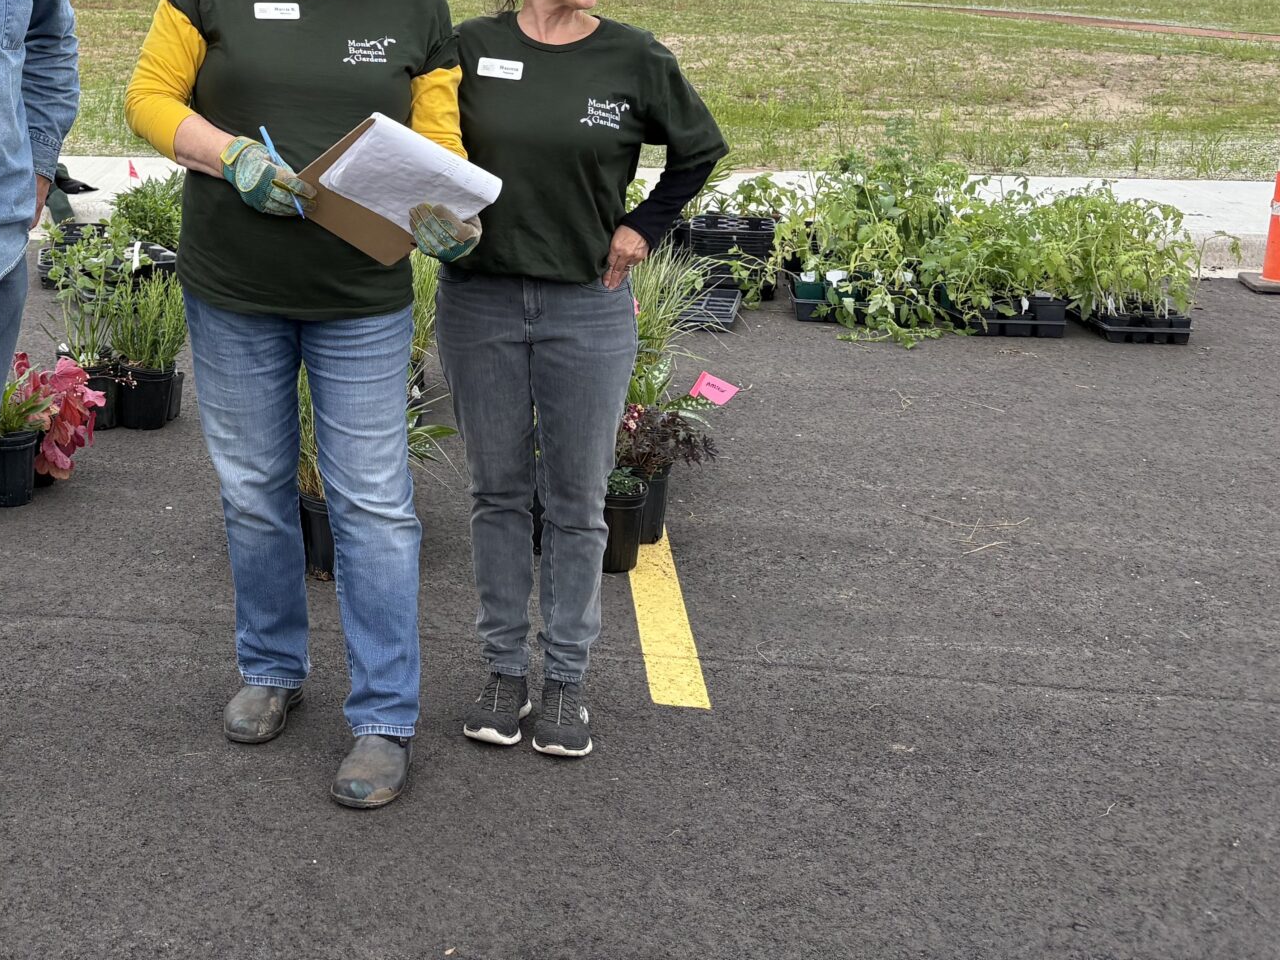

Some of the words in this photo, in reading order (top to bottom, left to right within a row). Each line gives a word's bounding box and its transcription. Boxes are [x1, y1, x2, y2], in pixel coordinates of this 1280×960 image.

[347, 38, 371, 48] Monk
[348, 46, 385, 56] Botanical
[354, 54, 387, 63] Gardens
[587, 97, 610, 110] Monk
[591, 115, 620, 130] Gardens
